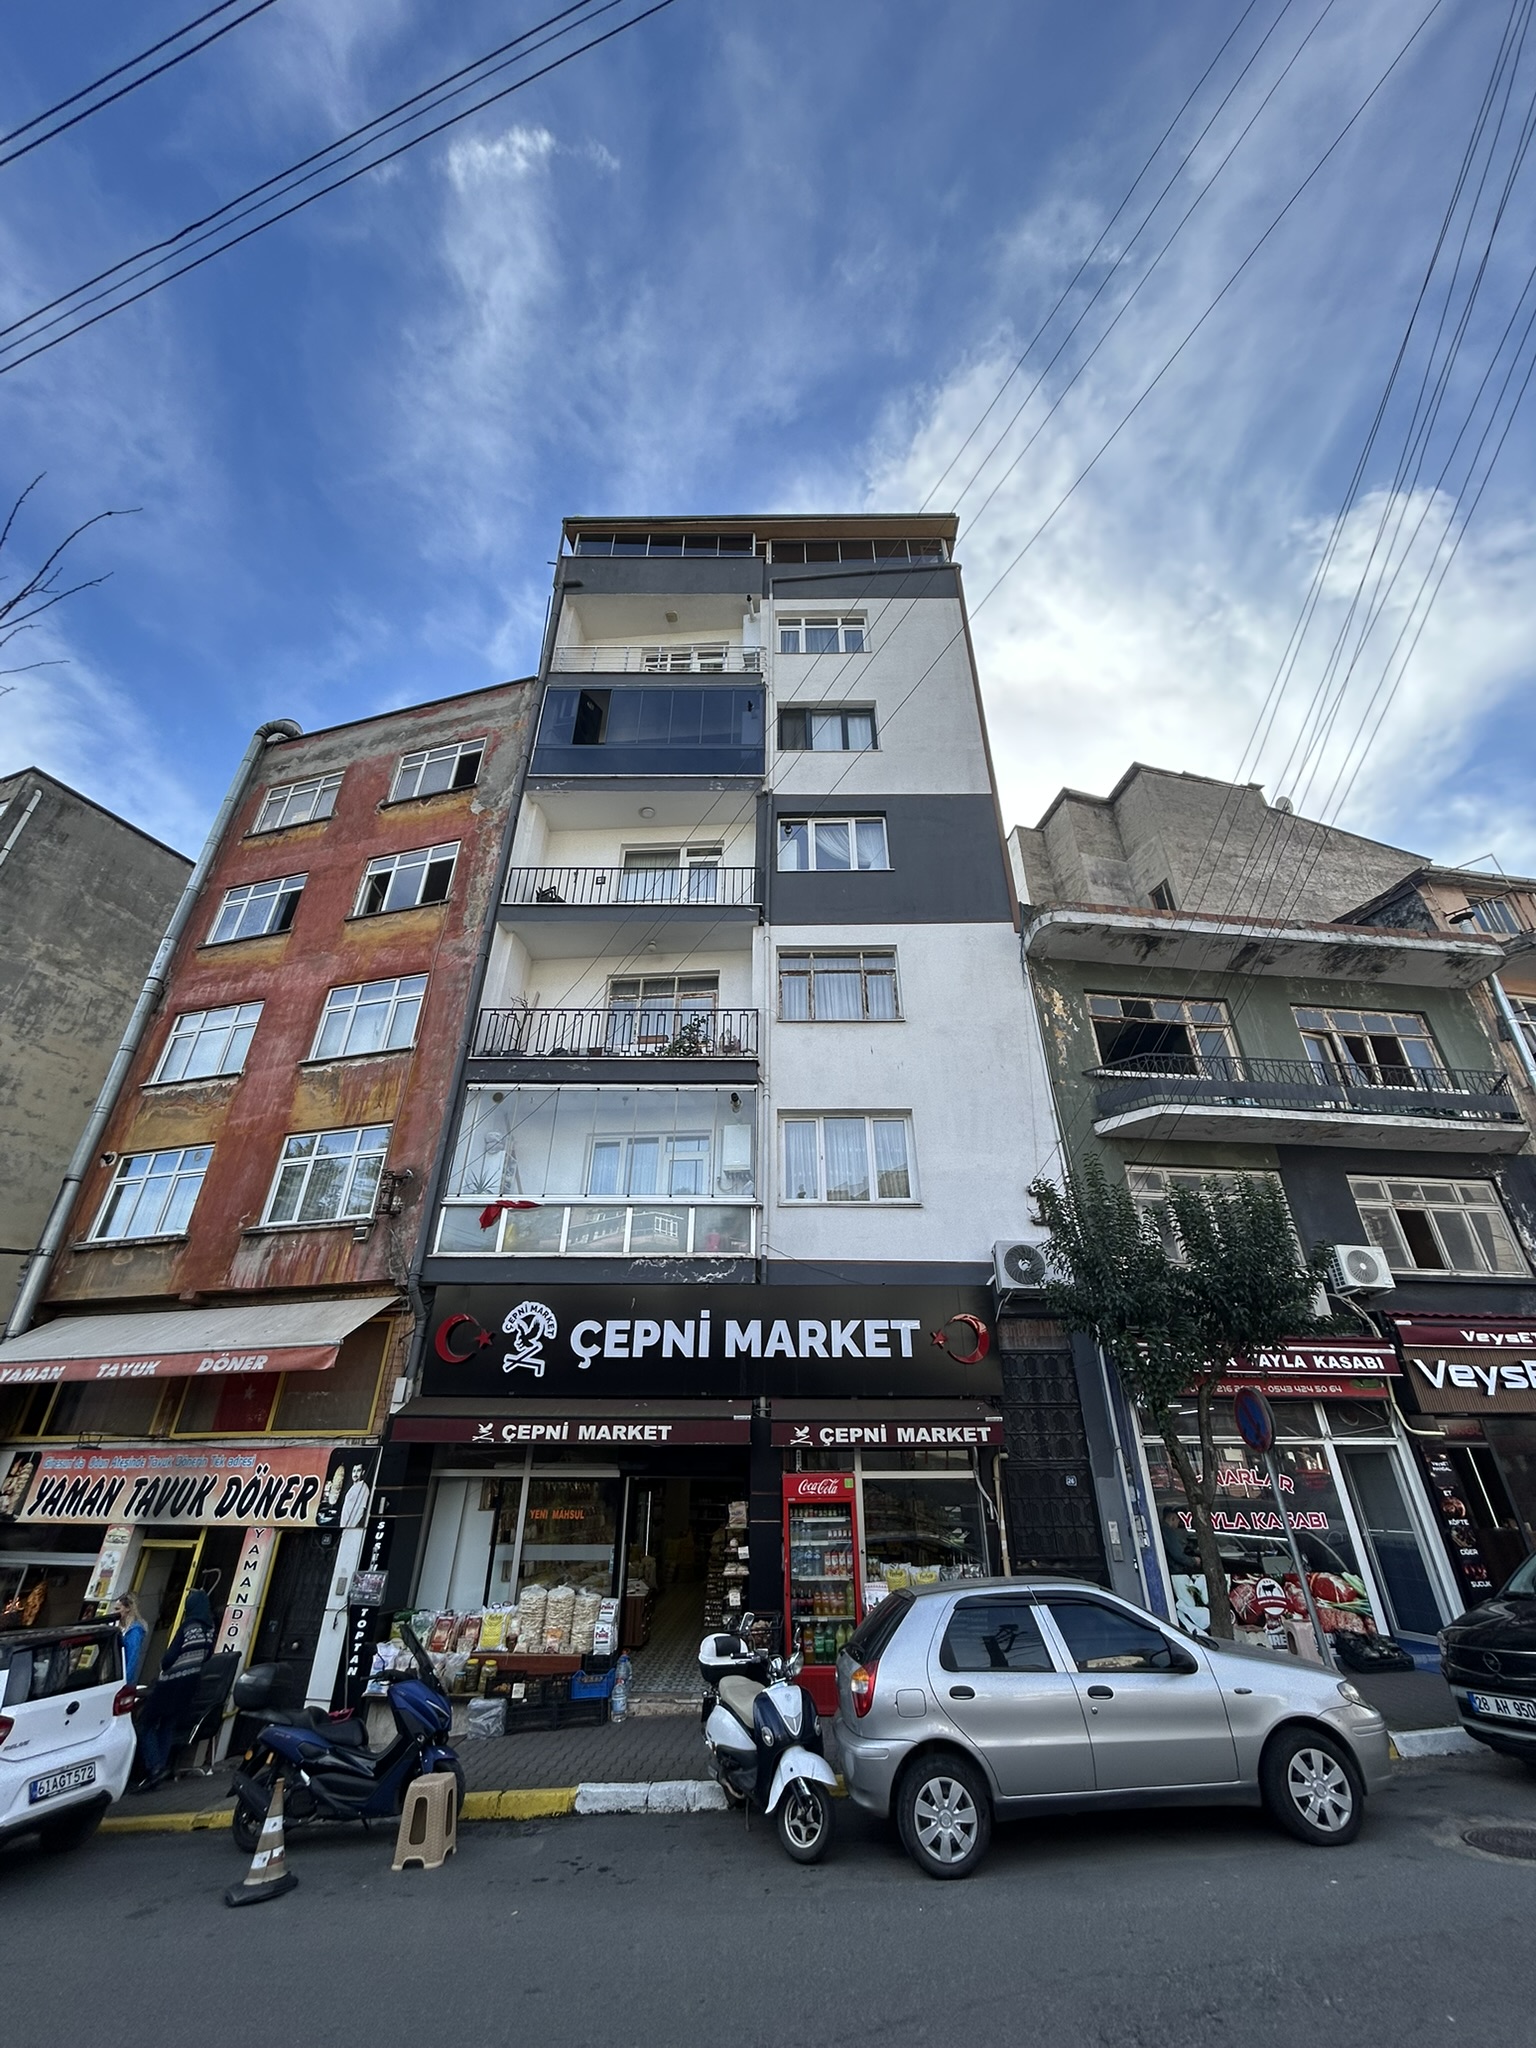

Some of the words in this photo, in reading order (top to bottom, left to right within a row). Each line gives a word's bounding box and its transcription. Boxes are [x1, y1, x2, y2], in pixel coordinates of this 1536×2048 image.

[505, 1304, 529, 1330] ÇEPNİ
[530, 1305, 555, 1336] MARKET
[570, 1309, 711, 1370] ÇEPNİ
[724, 1319, 921, 1359] MARKET
[0, 1365, 66, 1382] YAMAN
[96, 1360, 162, 1378] TAVUK
[196, 1353, 269, 1372] DÖNER
[1315, 1355, 1385, 1370] KASABI
[1268, 1385, 1294, 1393] 0543
[1296, 1385, 1315, 1393] 424
[501, 1421, 569, 1443] ÇEPNİ
[577, 1425, 672, 1440] MARKET
[819, 1424, 887, 1446] ÇEPNİ
[897, 1427, 991, 1443] MARKET
[148, 1456, 173, 1468] Tavuk
[210, 1456, 225, 1467] Tek
[226, 1455, 256, 1467] adresi
[27, 1476, 126, 1518] YAMAN
[124, 1475, 218, 1518] TAVUK
[214, 1464, 320, 1520] DÖNER
[1178, 1511, 1250, 1530] YYLA
[347, 1608, 370, 1676] TOPTAN
[1475, 1696, 1490, 1711] 28
[1494, 1699, 1511, 1715] AH
